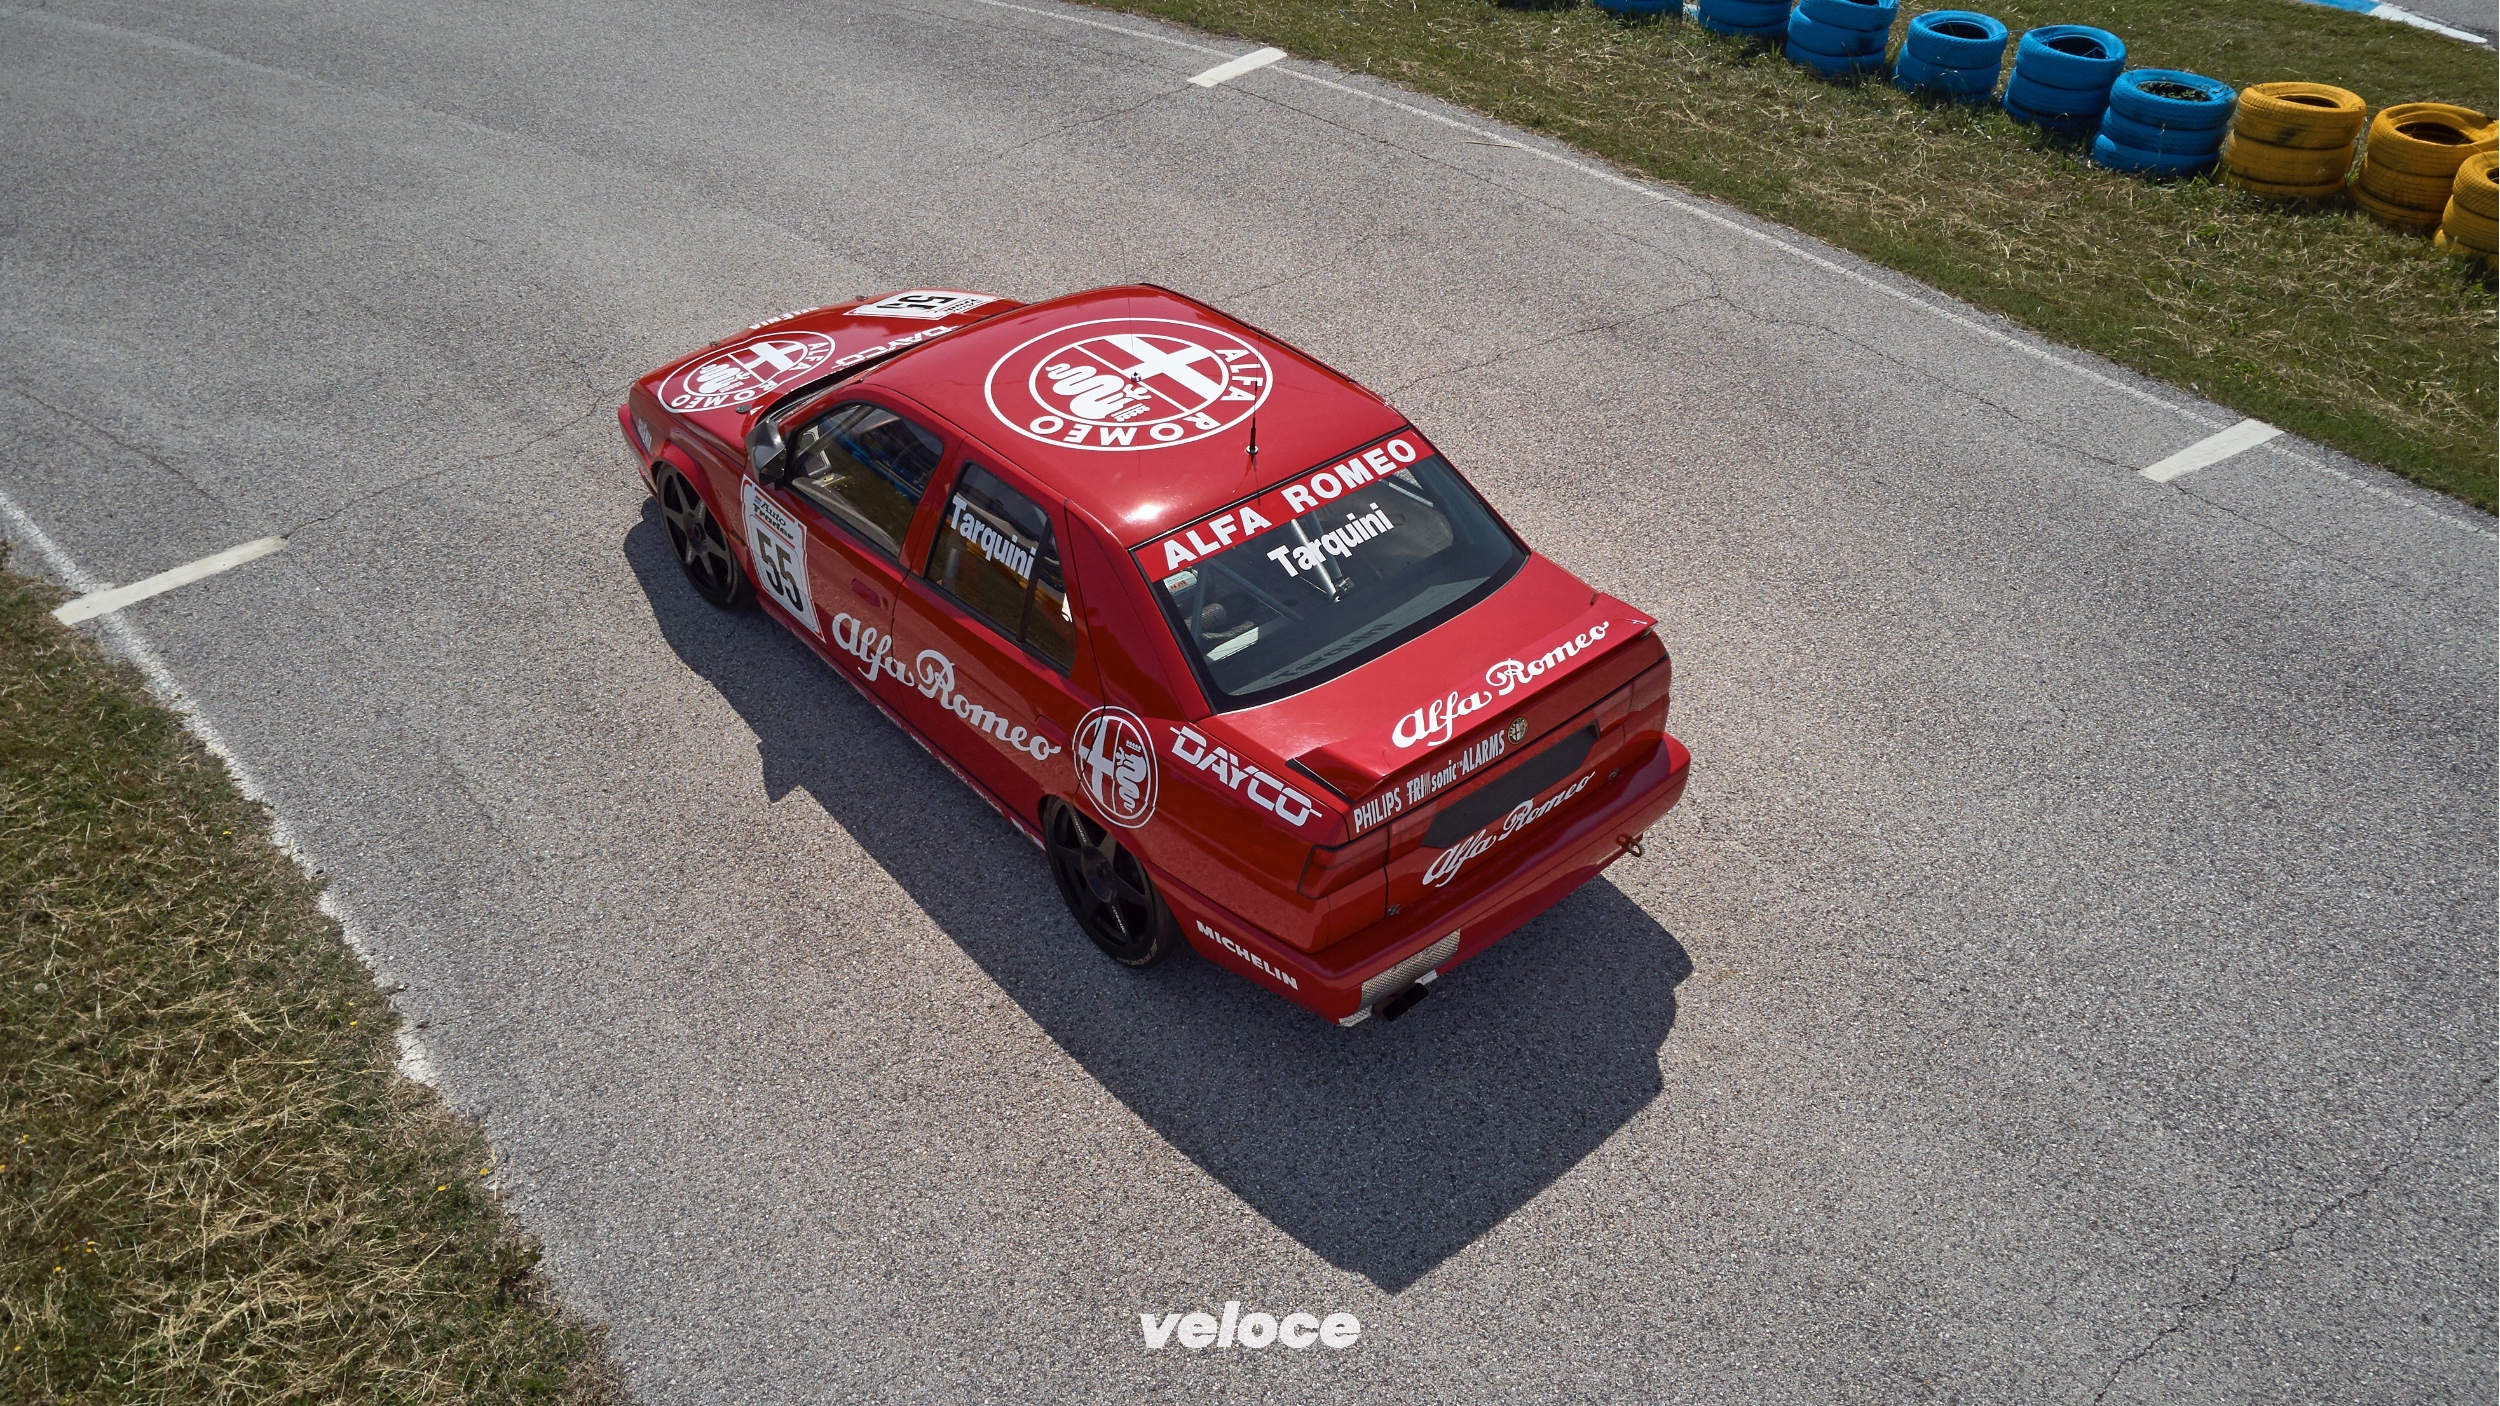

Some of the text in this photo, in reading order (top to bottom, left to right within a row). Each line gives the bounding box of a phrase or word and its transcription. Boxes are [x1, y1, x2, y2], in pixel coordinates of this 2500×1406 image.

[671, 342, 830, 409] ALFA ROMEO
[831, 325, 958, 369] DAYCO
[1030, 349, 1264, 446] ALFA ROMEO
[753, 503, 794, 541] Trader
[760, 501, 787, 527] Auto
[950, 495, 1038, 579] Tarquini
[1162, 439, 1417, 571] ALFA ROMEO
[1267, 502, 1394, 578] Tarquini
[756, 527, 804, 613] 55
[831, 613, 1061, 761] Alfa Romeo
[1391, 620, 1610, 749] Alfa Romeo
[1169, 726, 1322, 827] DAYCO
[1353, 787, 1402, 833] PHILIPS
[1462, 730, 1505, 776] ALARMS
[1423, 772, 1596, 887] Alfa Romeo
[1196, 919, 1299, 991] MICHELIN
